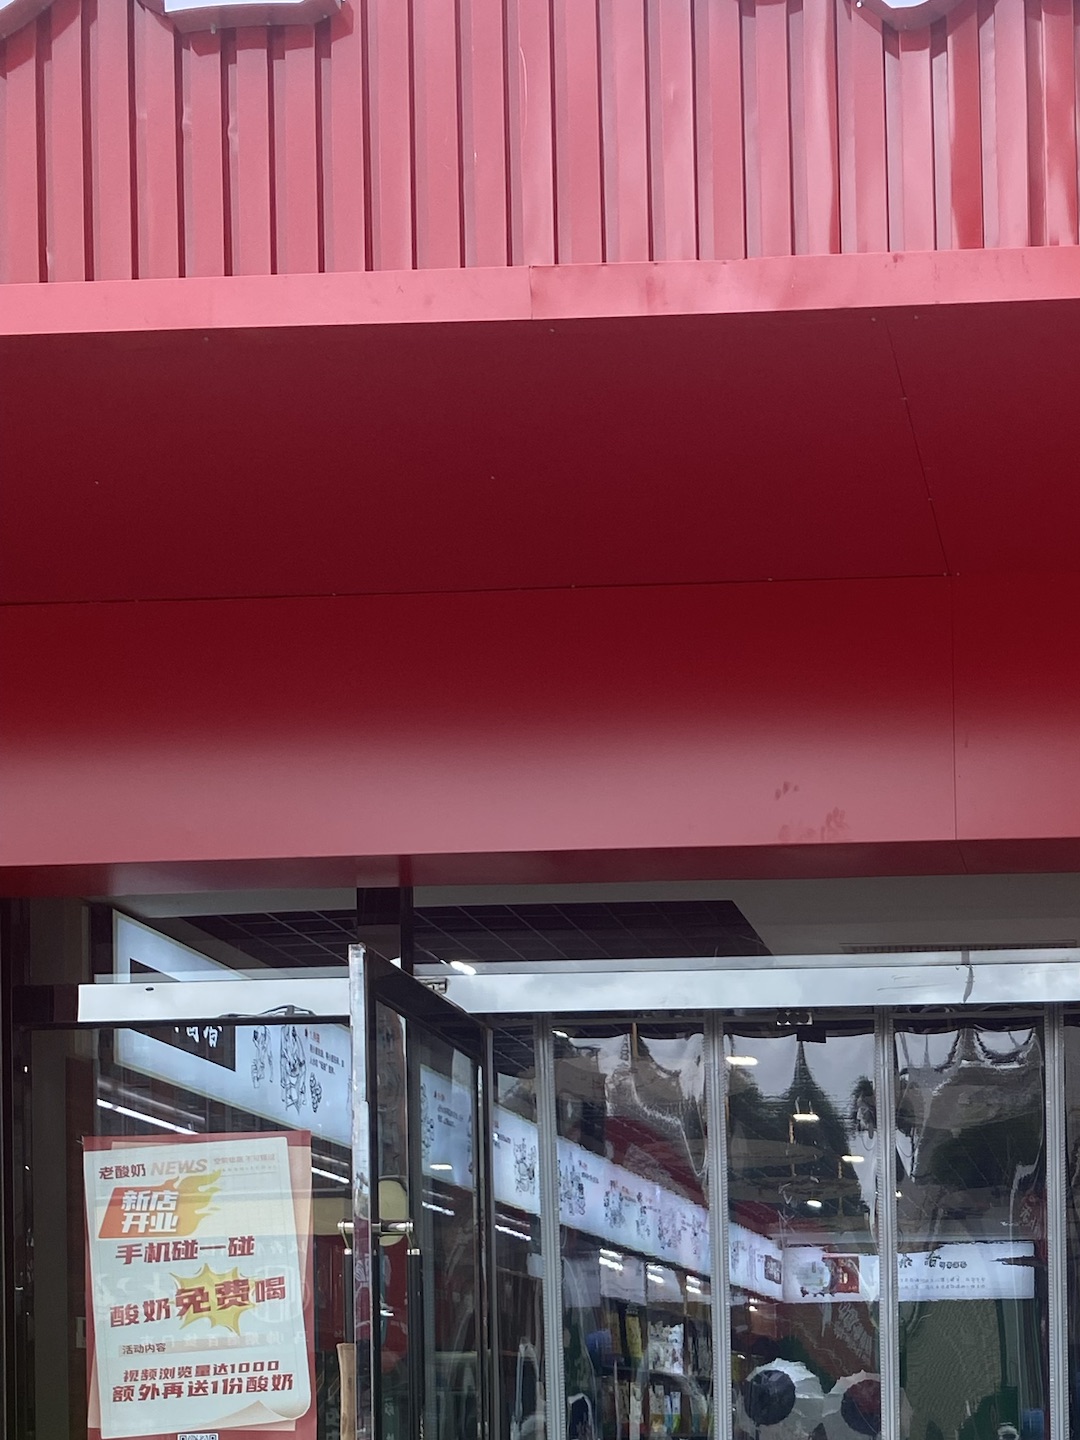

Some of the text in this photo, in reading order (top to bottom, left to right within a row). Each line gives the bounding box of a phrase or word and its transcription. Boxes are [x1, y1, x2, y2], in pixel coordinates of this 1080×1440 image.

[98, 1163, 146, 1180] 老酸奶
[150, 1158, 208, 1177] NEWS
[121, 1190, 179, 1211] 新店
[121, 1212, 179, 1234] 开业
[115, 1235, 255, 1265] 手机碰一碰
[110, 1275, 286, 1328] 酸奶免费喝
[122, 1343, 166, 1355] 活动内容
[123, 1360, 280, 1383] 视频浏览量达1000
[112, 1373, 293, 1403] 额外再送1份酸奶
